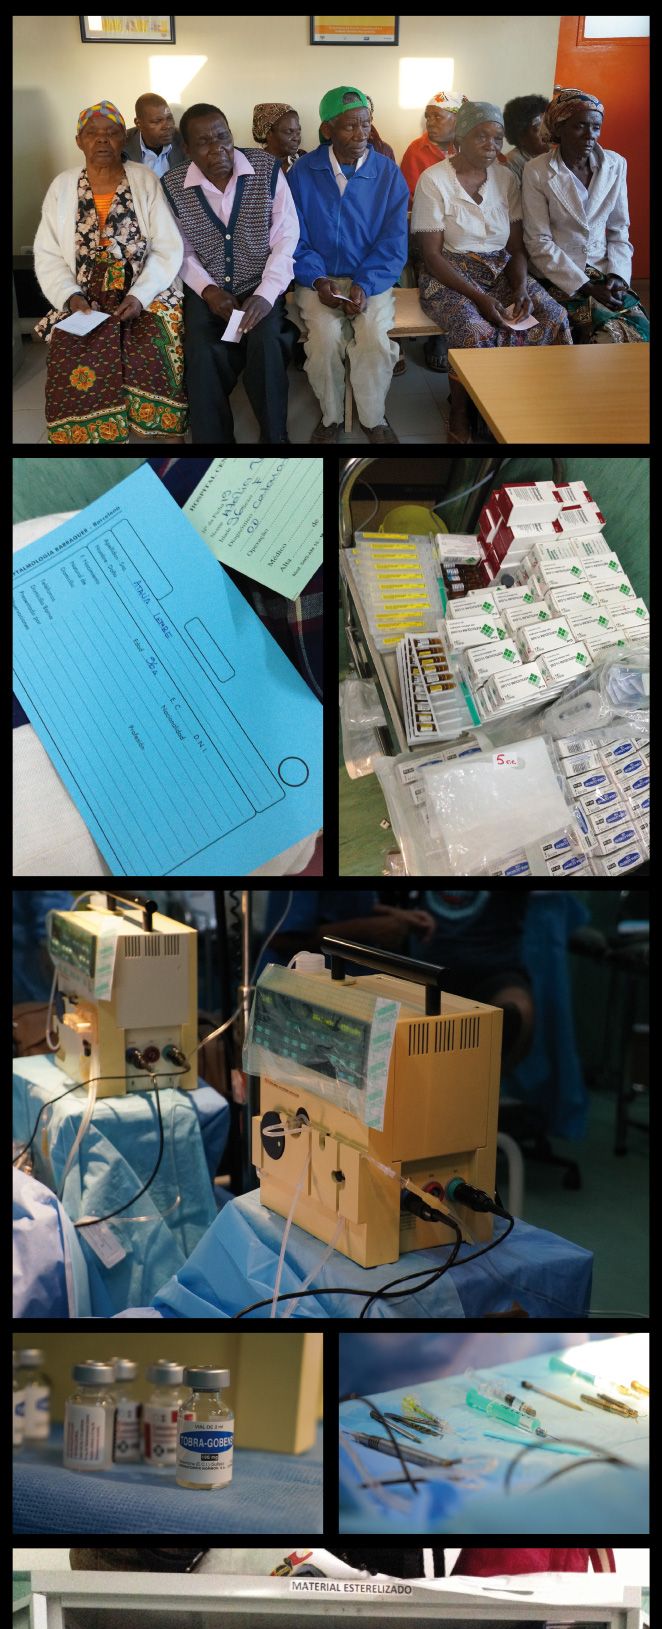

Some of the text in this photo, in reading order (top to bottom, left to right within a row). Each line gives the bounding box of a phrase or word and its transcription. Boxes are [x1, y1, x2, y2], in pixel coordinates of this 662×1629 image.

[54, 528, 88, 553] BARRAQUER
[267, 543, 287, 567] Médico
[280, 558, 292, 572] Alta
[161, 704, 186, 741] Nacionalidad
[128, 724, 145, 751] Profesión
[496, 753, 505, 766] 5
[292, 1581, 412, 1594] MATERIAL ESTERELIZADO
